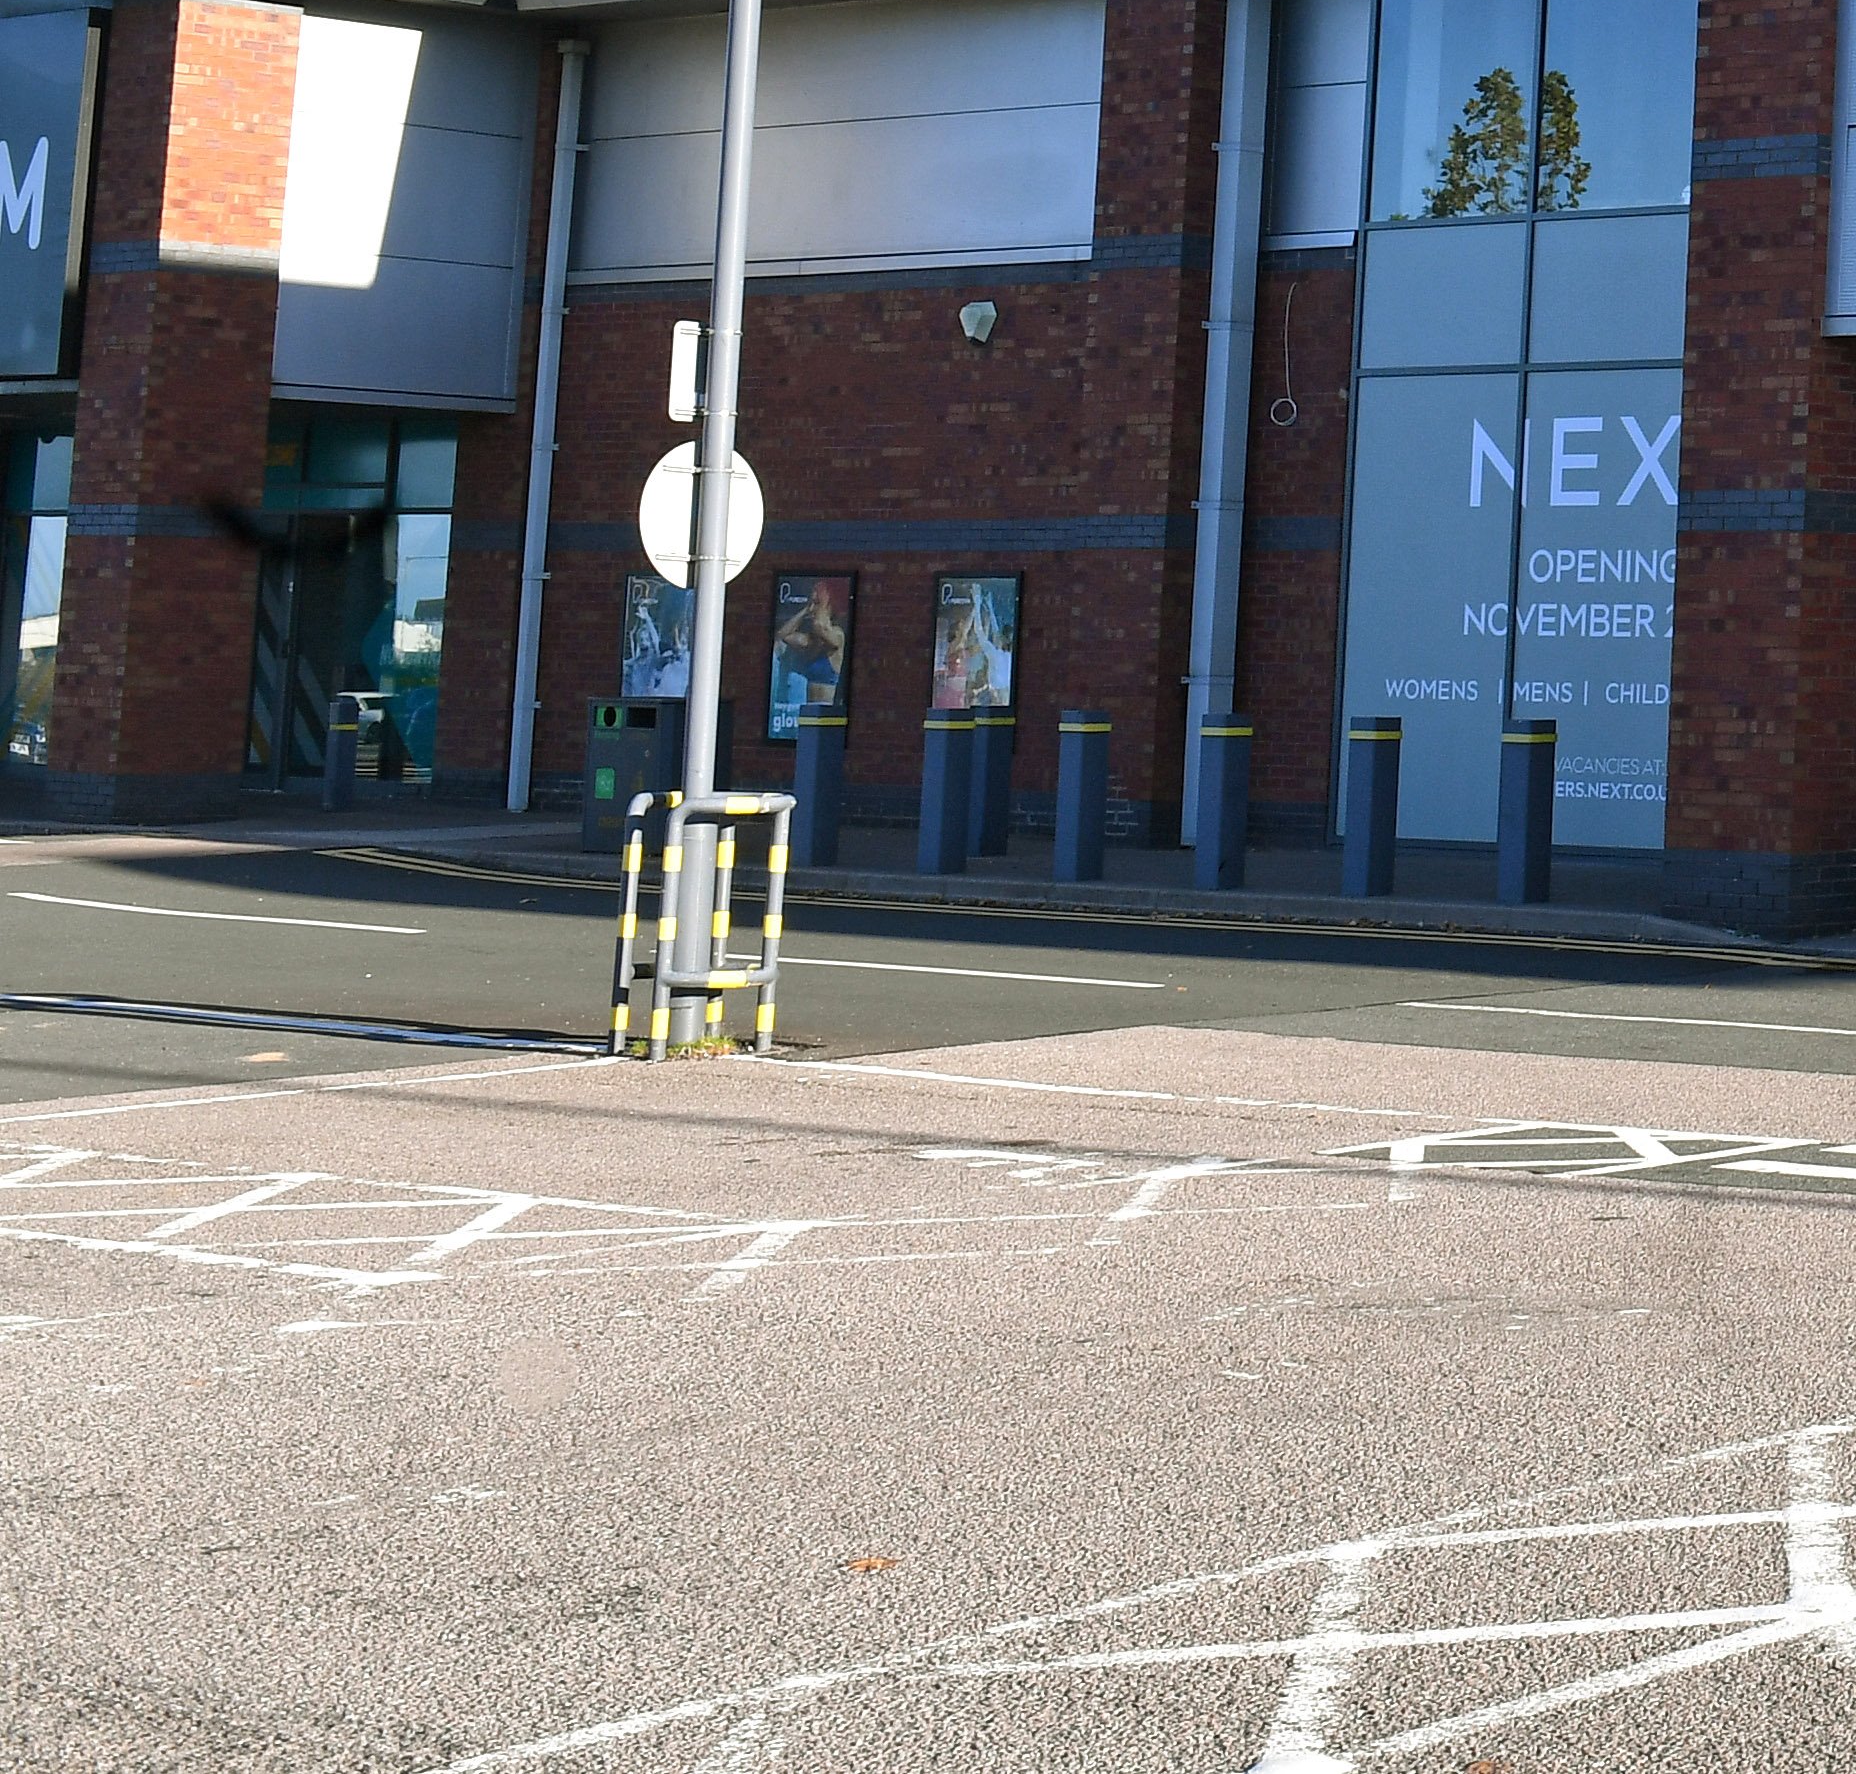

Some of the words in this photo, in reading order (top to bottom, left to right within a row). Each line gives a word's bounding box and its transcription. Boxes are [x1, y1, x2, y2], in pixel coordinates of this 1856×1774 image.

[1463, 602, 1656, 638] NOVEMBER
[1385, 679, 1479, 702] WOMENS
[1513, 681, 1573, 704] MENS
[1604, 682, 1670, 705] CHILD
[1641, 759, 1665, 776] AT:
